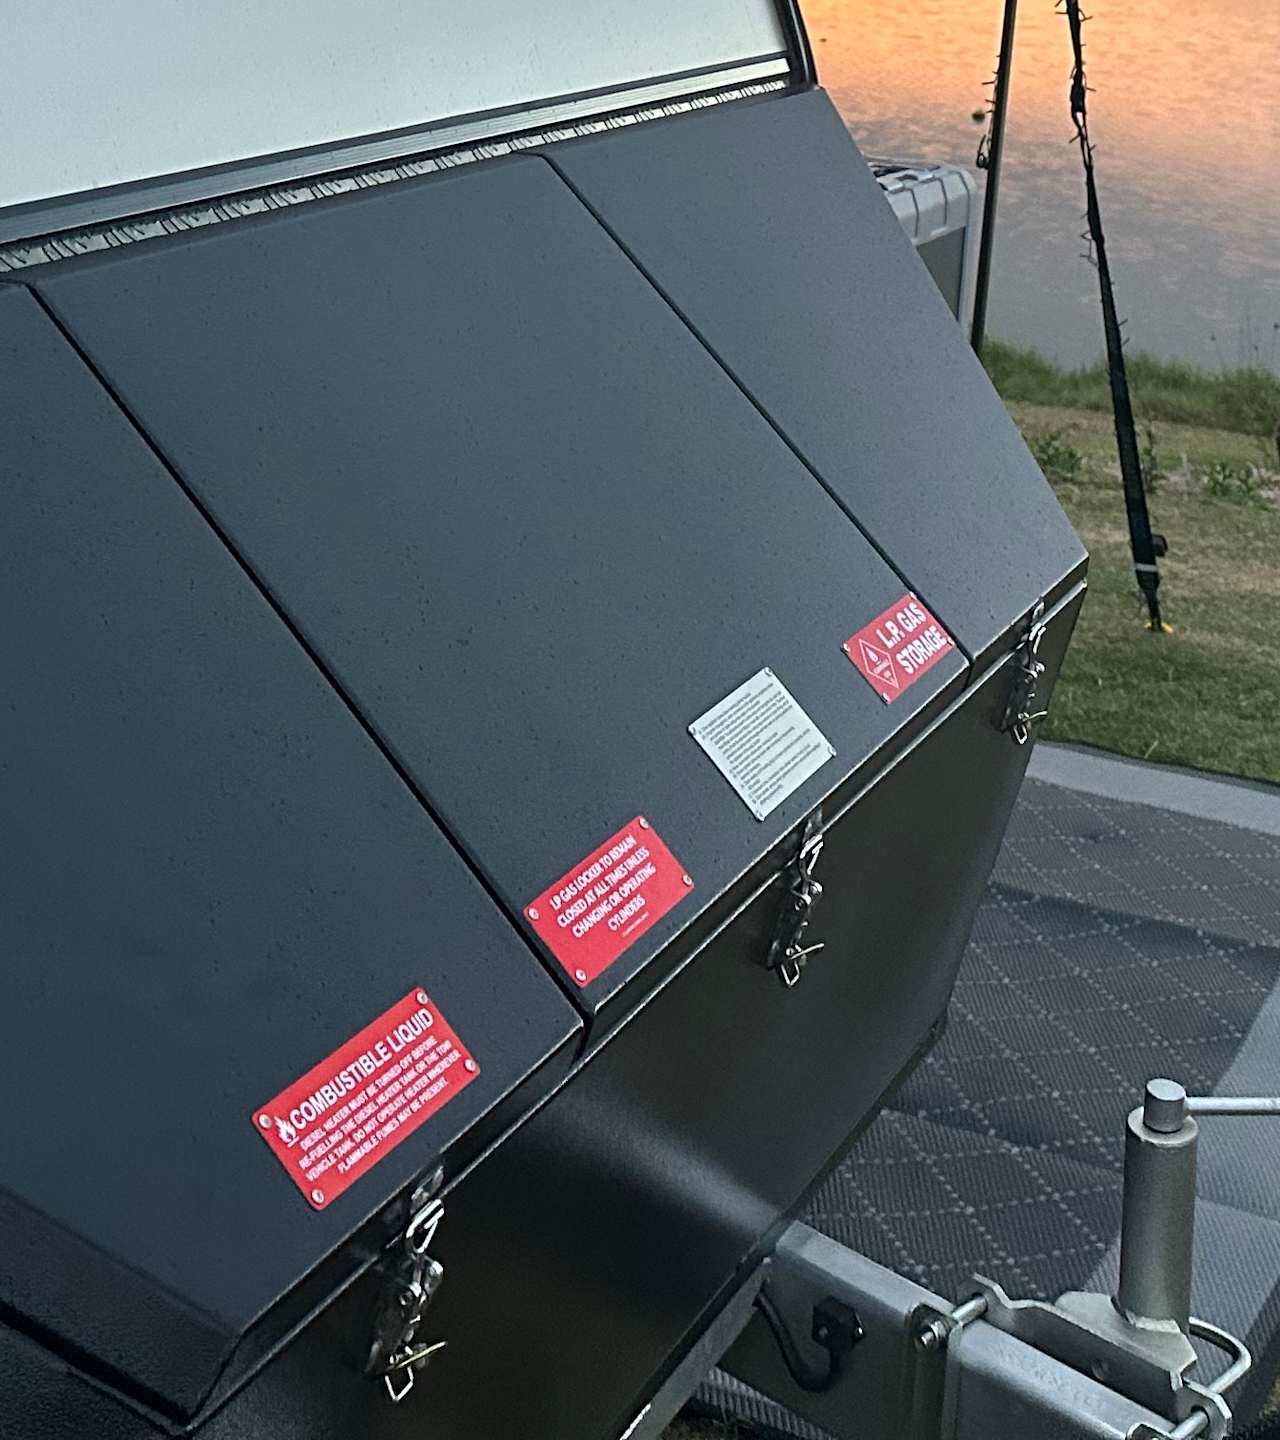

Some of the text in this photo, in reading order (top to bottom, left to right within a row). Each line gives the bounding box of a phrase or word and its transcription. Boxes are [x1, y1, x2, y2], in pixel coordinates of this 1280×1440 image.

[876, 603, 926, 648] L.P. GAS
[896, 625, 947, 673] STORAGE
[557, 847, 648, 926] CLOSED AT ALL TIMES UNLESS
[559, 883, 577, 901] GAS
[574, 863, 602, 889] LOCKER
[600, 855, 612, 867] TO
[610, 835, 635, 859] REMAIN
[572, 900, 611, 936] CHANGING
[609, 891, 621, 905] OR
[619, 863, 655, 896] OPERATING
[288, 1007, 434, 1130] COMBUSTIBLE LIQUID
[301, 1127, 324, 1149] DIESEL
[324, 1107, 349, 1130] HEATER
[349, 1092, 367, 1109] MUST
[366, 1084, 376, 1095] BE
[400, 1055, 412, 1068] OFF
[342, 1120, 355, 1133] THE
[354, 1102, 376, 1122] DIESEL
[376, 1082, 400, 1104] HEATER
[400, 1069, 416, 1085] TANK
[416, 1061, 426, 1071] OR
[425, 1051, 437, 1063] THE
[307, 1153, 335, 1180] VEHICLE
[353, 1129, 364, 1141] DO
[364, 1118, 377, 1132] NOT
[377, 1095, 405, 1121] OPERATE
[405, 1075, 428, 1098] HEATER
[338, 1136, 377, 1172] FLAMMABLE
[397, 1107, 411, 1121] MAY
[410, 1100, 420, 1111] BE
